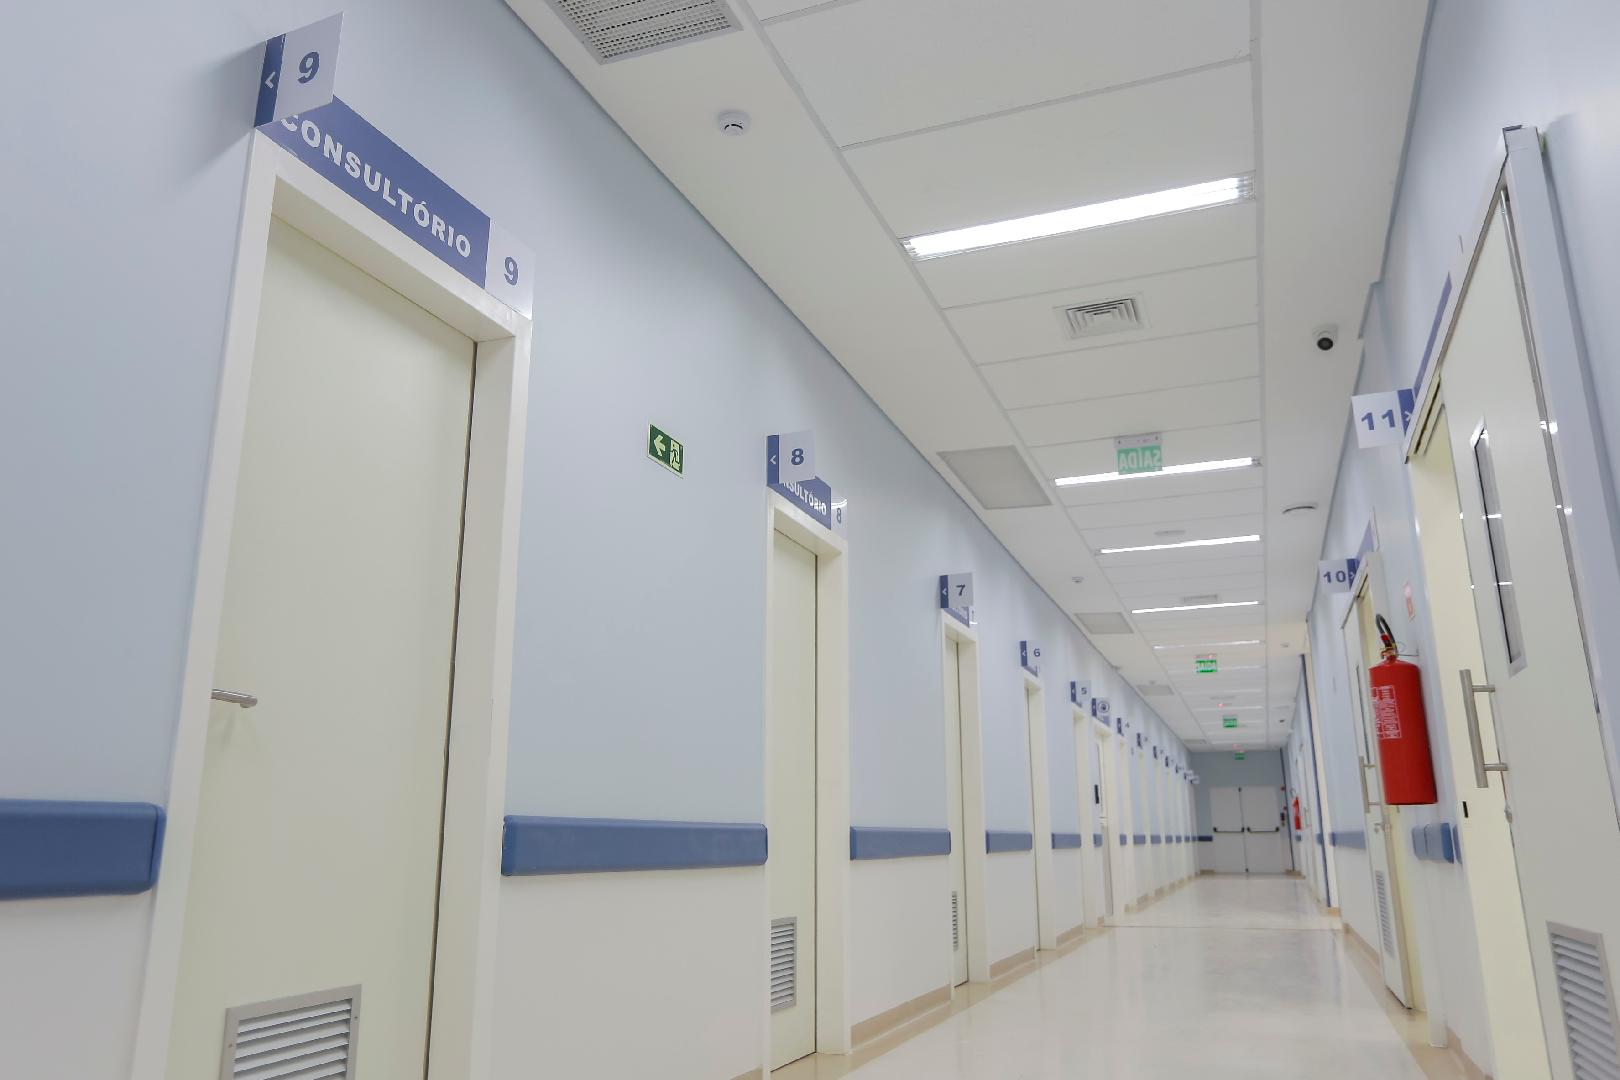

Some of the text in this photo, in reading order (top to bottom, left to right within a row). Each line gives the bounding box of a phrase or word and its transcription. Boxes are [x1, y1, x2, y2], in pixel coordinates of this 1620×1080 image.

[297, 51, 320, 84] 9
[281, 115, 519, 286] CONSULTÓRIO 9
[1361, 409, 1396, 431] 11
[791, 448, 804, 465] 8
[836, 507, 842, 524] 8
[1323, 570, 1346, 584] 10
[956, 584, 966, 596] 7
[1033, 648, 1041, 657] 6
[1081, 687, 1088, 695] 5
